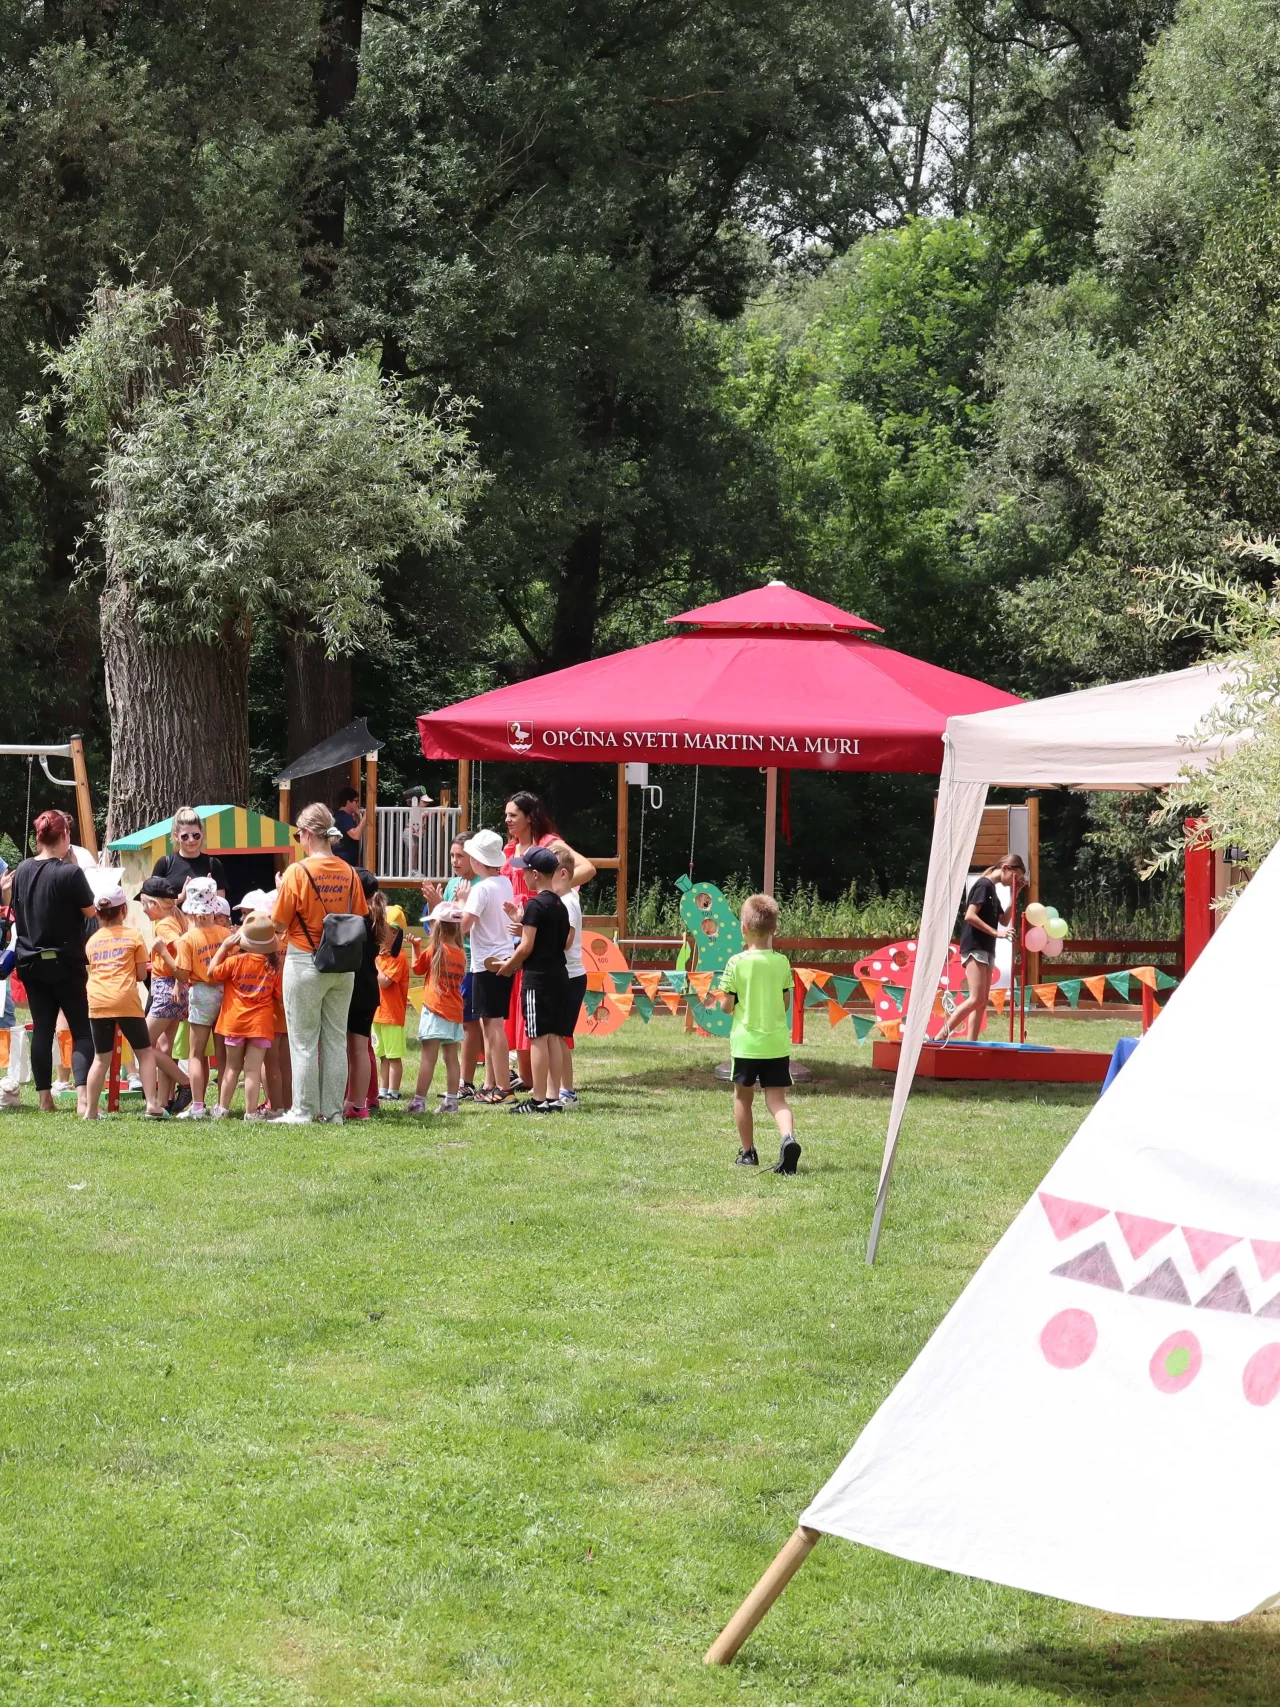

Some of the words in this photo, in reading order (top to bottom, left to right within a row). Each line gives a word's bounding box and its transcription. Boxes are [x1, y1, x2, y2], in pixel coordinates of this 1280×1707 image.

[542, 727, 618, 747] OPĆINA
[622, 731, 678, 748] SVETI
[683, 733, 764, 751] MARTIN
[769, 735, 799, 752] NA
[804, 737, 860, 755] MURI
